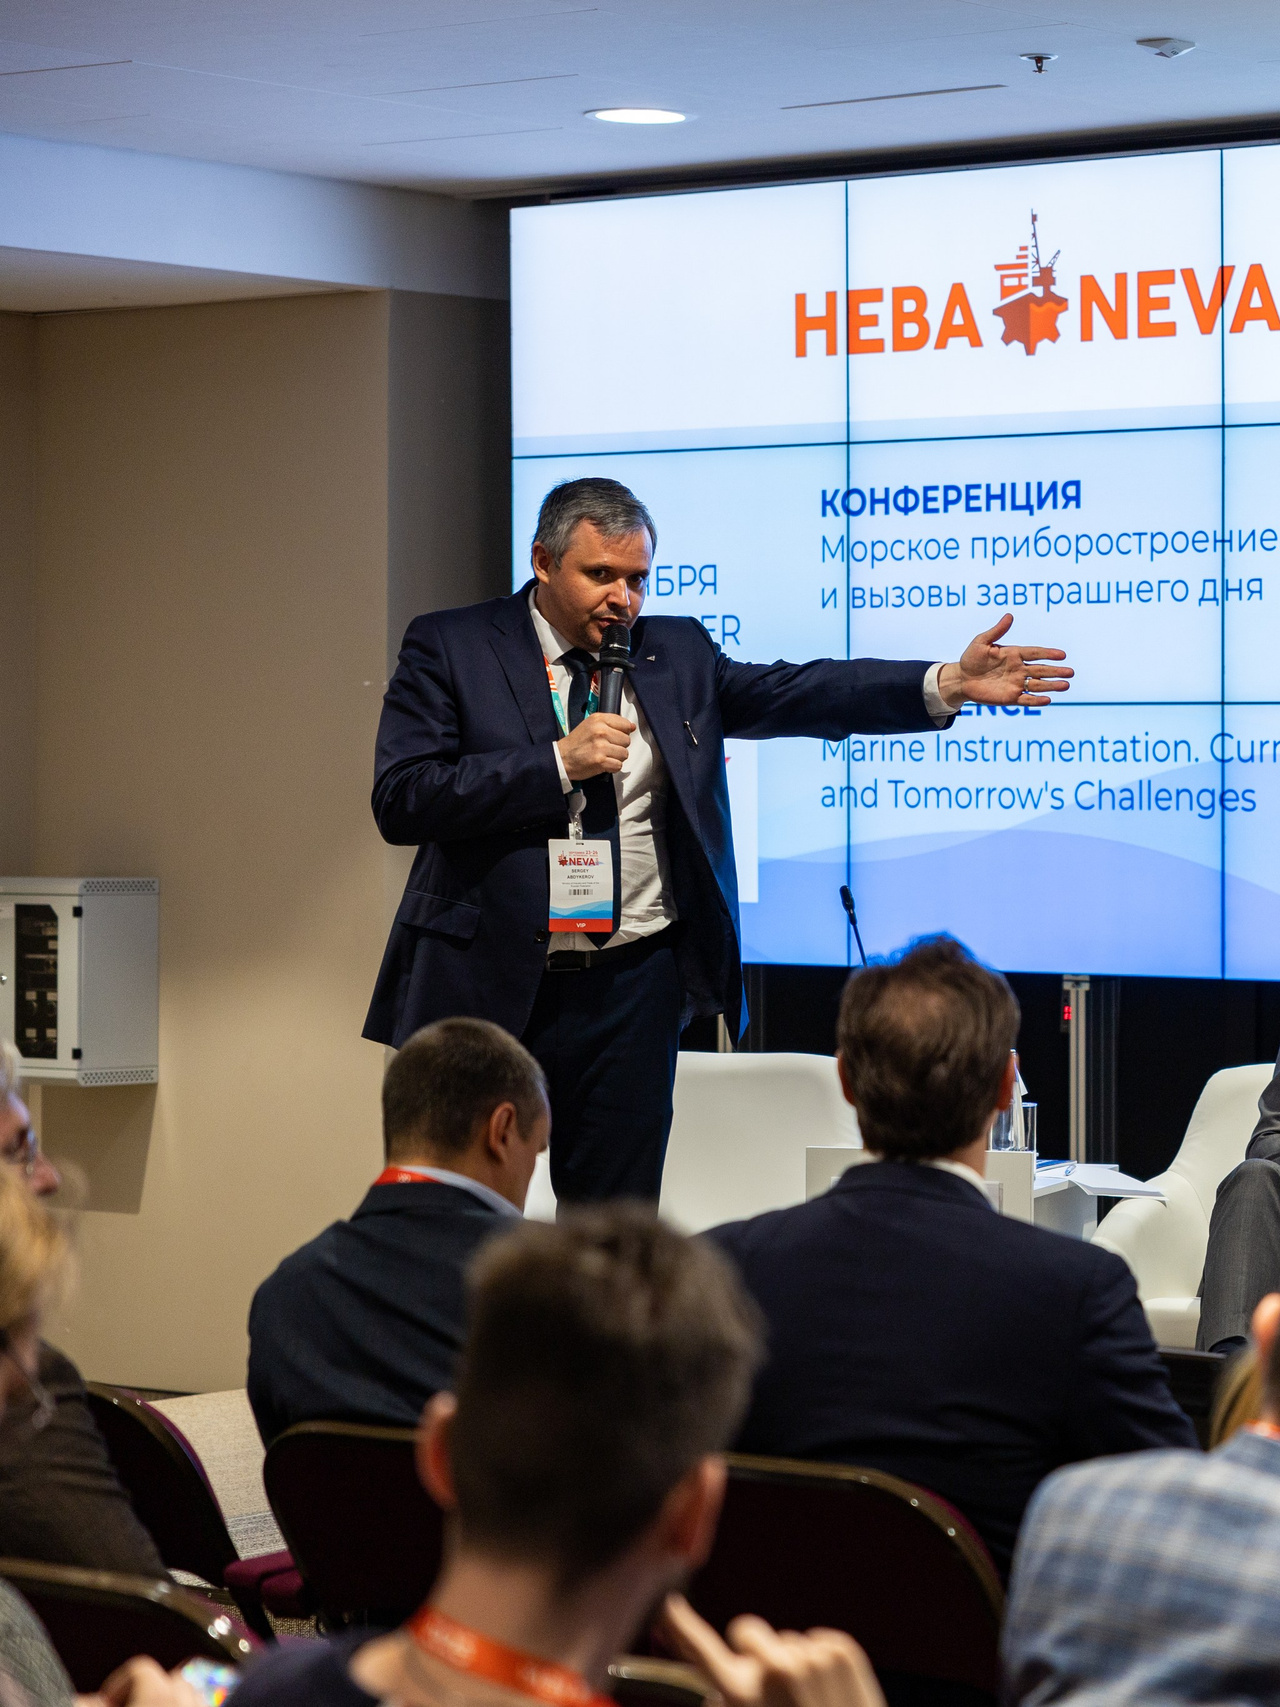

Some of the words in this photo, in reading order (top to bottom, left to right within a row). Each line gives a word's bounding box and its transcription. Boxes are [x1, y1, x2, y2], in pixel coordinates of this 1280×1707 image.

[795, 282, 984, 358] НЕВА
[820, 479, 1082, 518] КОНФЕРЕНЦИЯ
[821, 533, 960, 568] Морское
[820, 587, 838, 609] и
[850, 581, 967, 609] вызовы
[977, 577, 1189, 612] завтрашнего
[1198, 574, 1264, 607] дня
[821, 734, 925, 763] Marine
[936, 731, 1200, 763] Instrumentation.
[821, 778, 879, 809] and
[888, 780, 1065, 811] Tomorrow's
[1074, 779, 1257, 820] Challenges
[569, 857, 595, 866] NEVA
